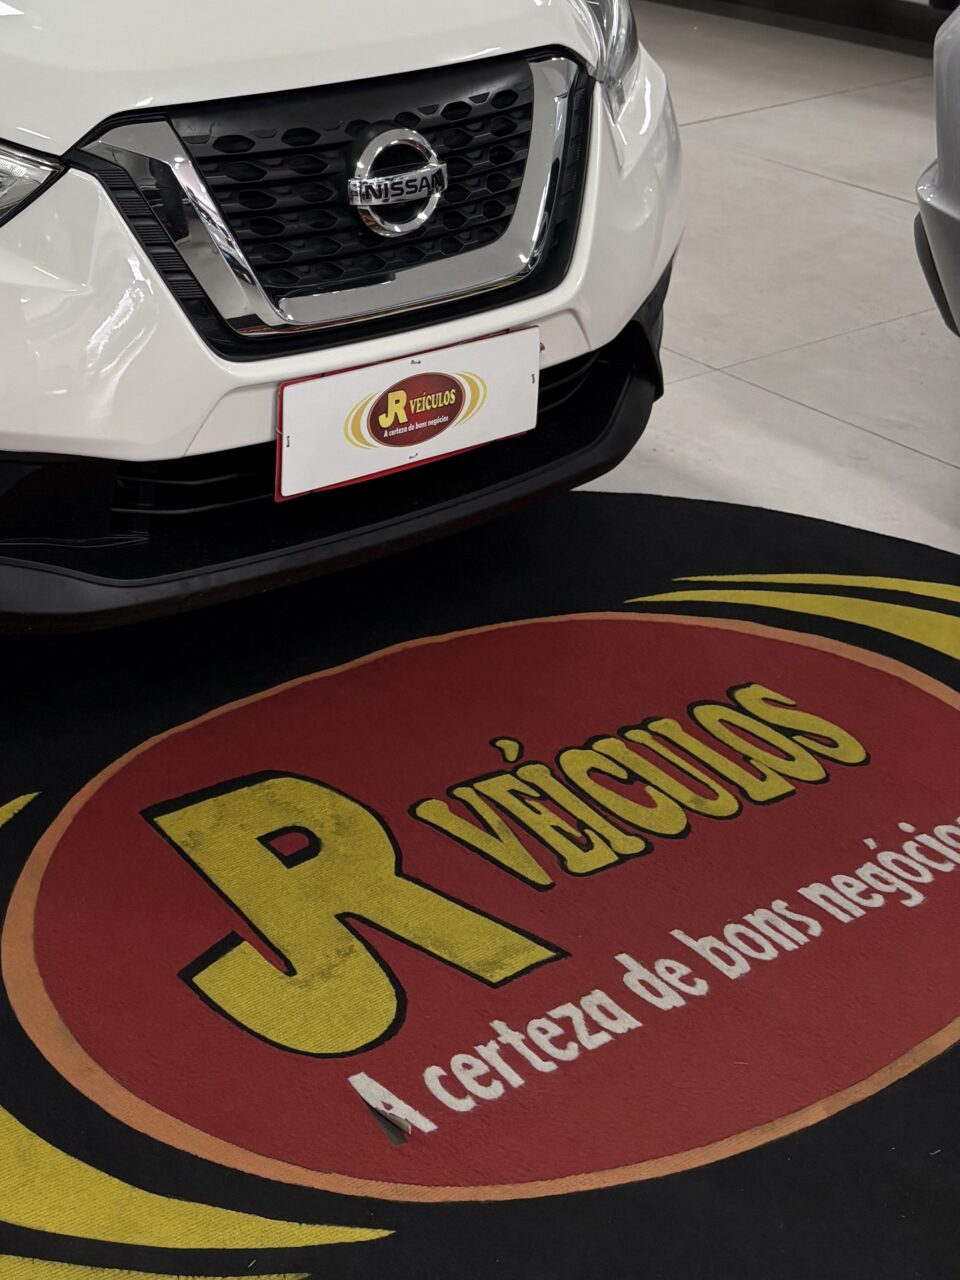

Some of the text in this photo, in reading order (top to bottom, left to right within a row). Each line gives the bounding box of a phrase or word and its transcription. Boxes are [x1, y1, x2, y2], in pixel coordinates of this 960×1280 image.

[364, 169, 445, 200] NISSAN
[378, 388, 456, 429] JR VEÍCULOS
[389, 427, 407, 437] certeza
[408, 423, 415, 432] de
[140, 681, 869, 1059] JR VEÍCULOS
[347, 816, 960, 1136] A certeza de bons negóci
